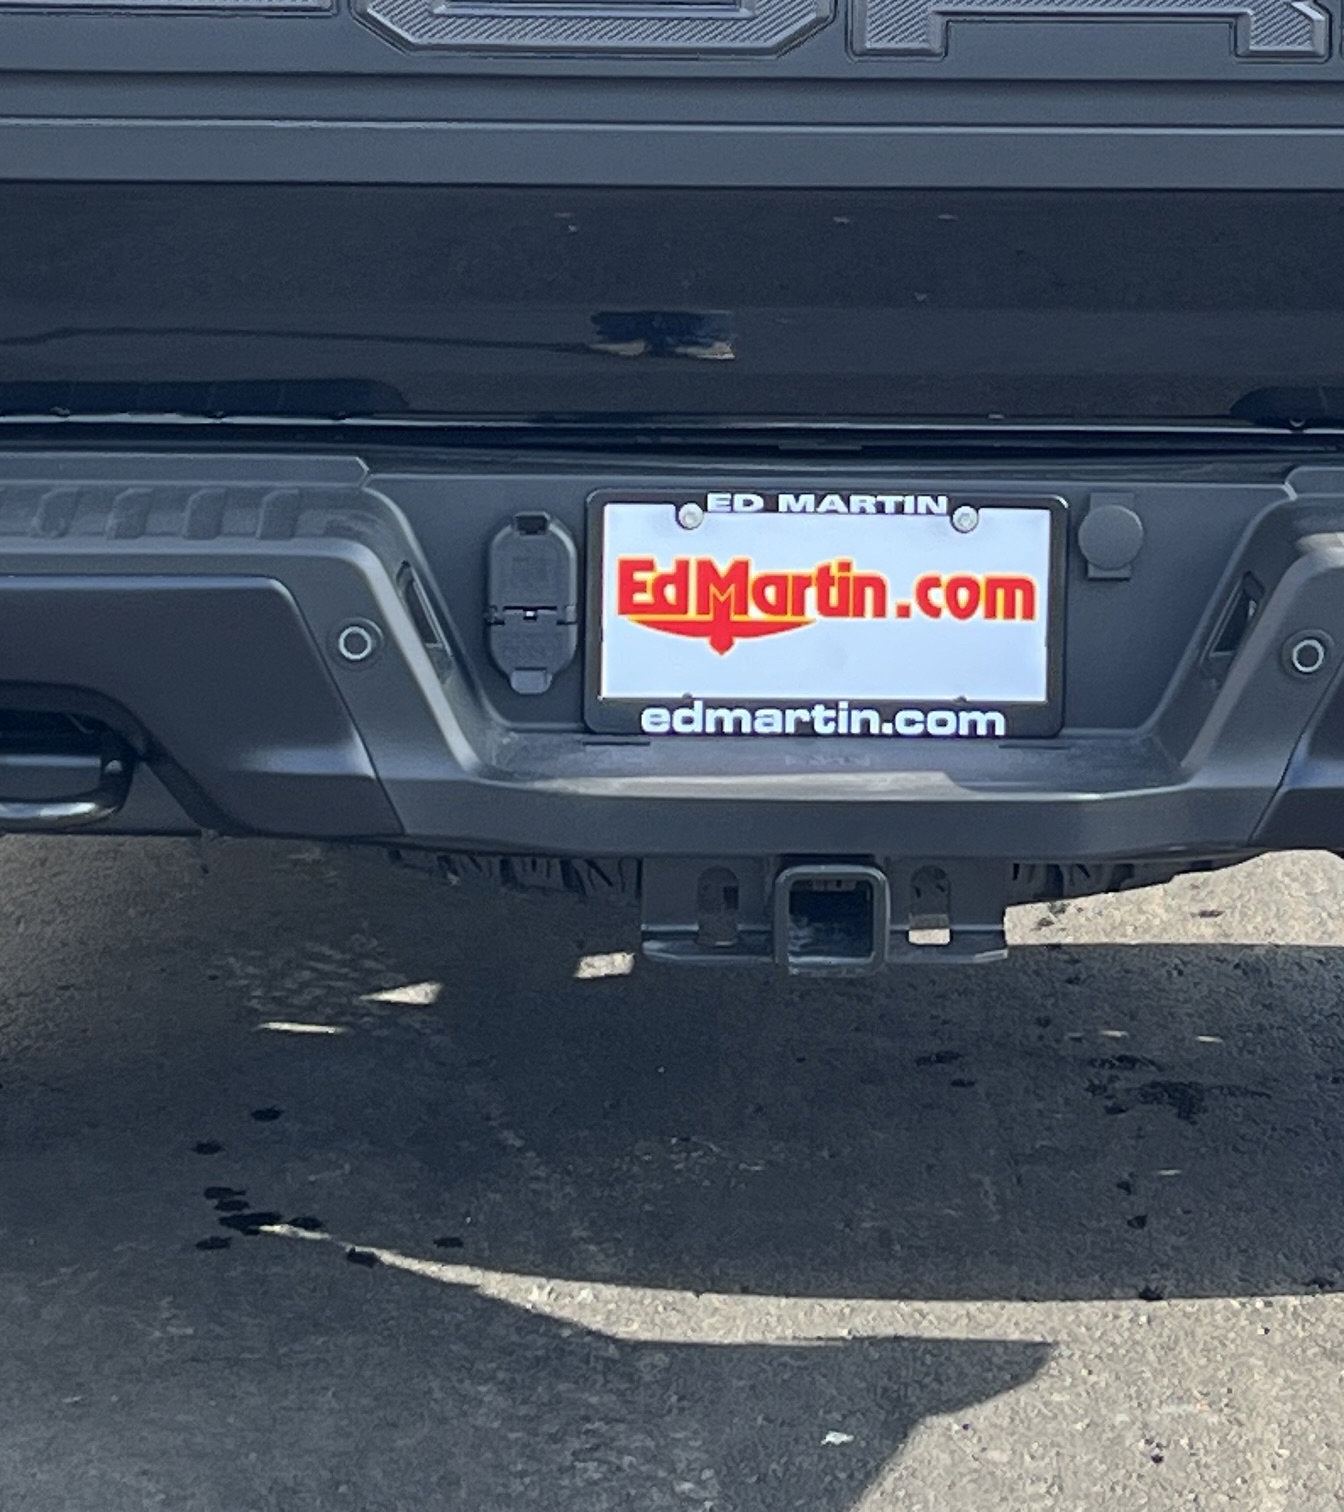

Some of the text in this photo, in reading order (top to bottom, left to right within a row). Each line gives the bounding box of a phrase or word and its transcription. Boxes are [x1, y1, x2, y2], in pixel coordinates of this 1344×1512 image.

[707, 492, 948, 515] ED MARTIN
[641, 701, 1006, 737] edmartin.com
